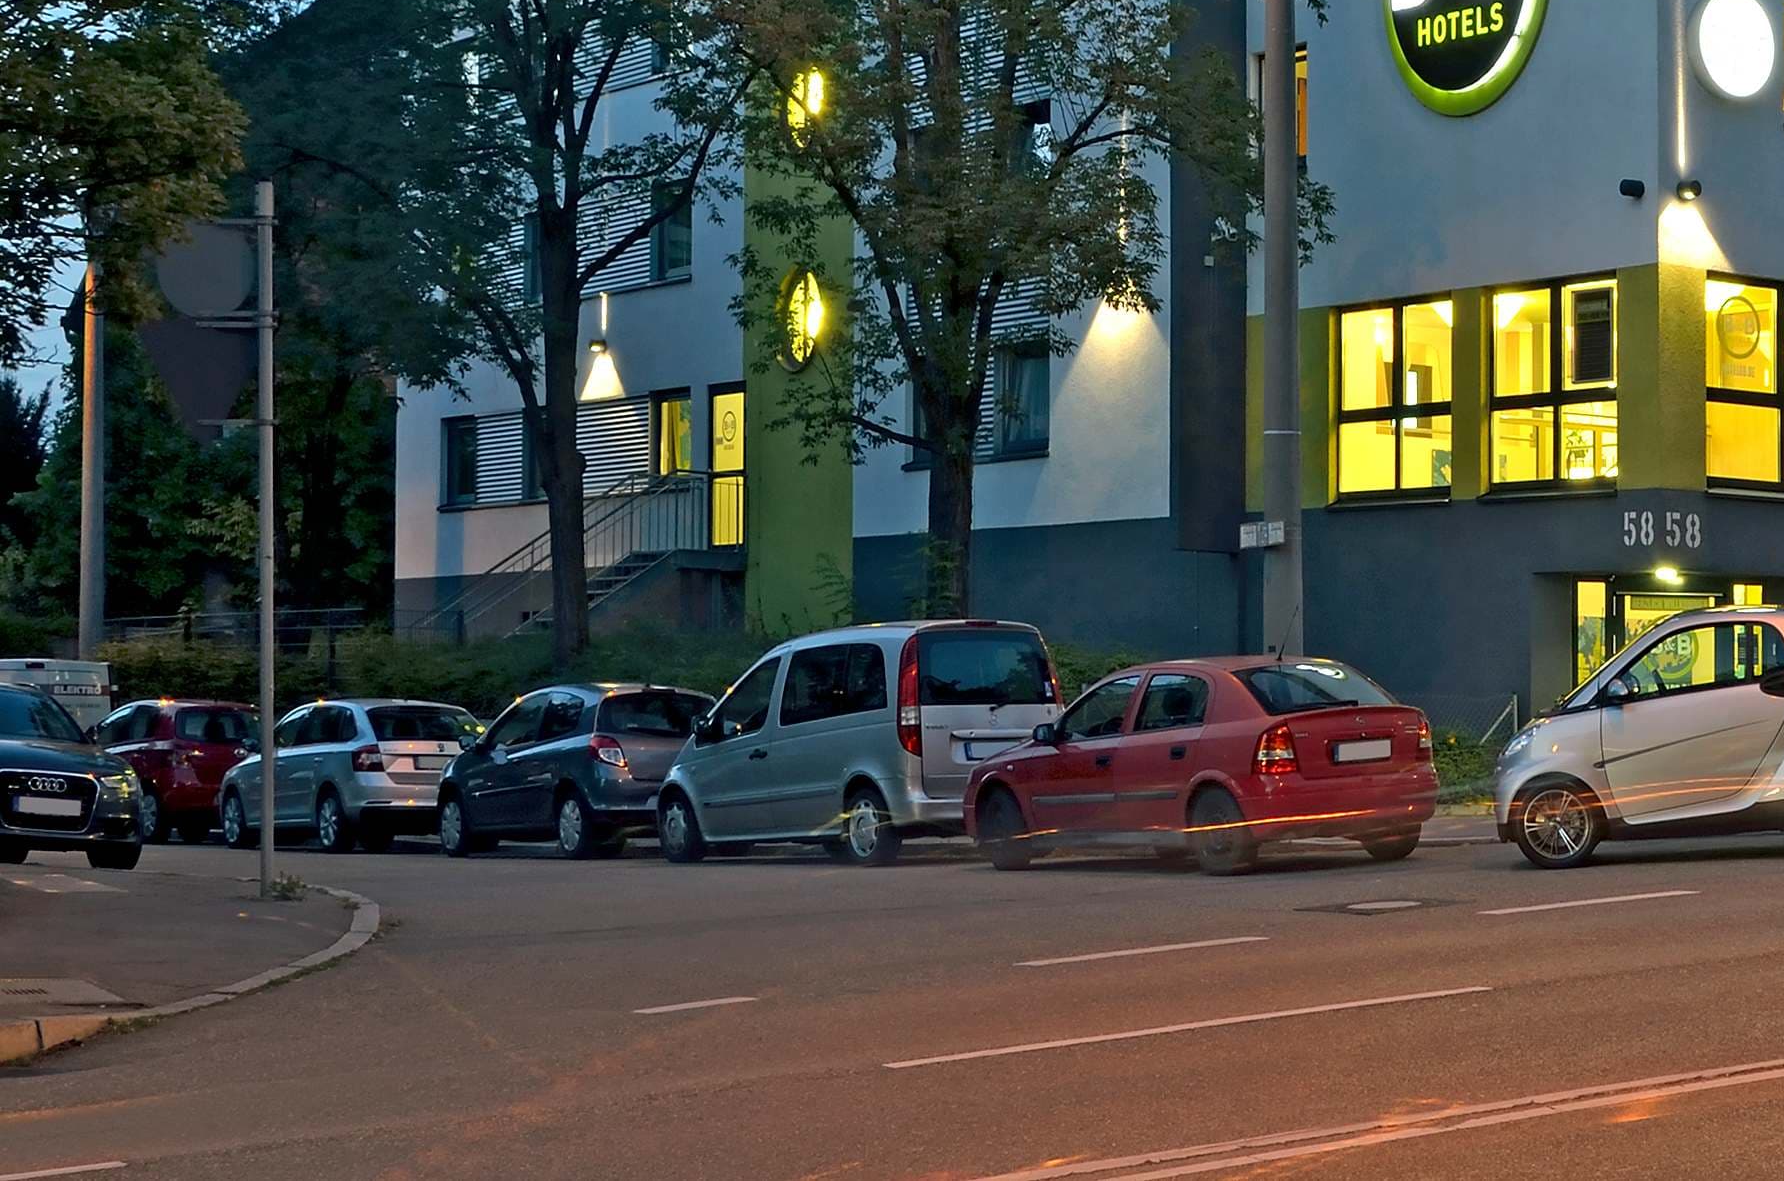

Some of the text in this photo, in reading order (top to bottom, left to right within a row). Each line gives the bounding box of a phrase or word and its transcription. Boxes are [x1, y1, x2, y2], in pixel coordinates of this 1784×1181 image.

[1417, 2, 1504, 47] HOTELS
[1623, 511, 1701, 549] 58 58
[54, 684, 102, 695] ELEKTRO
